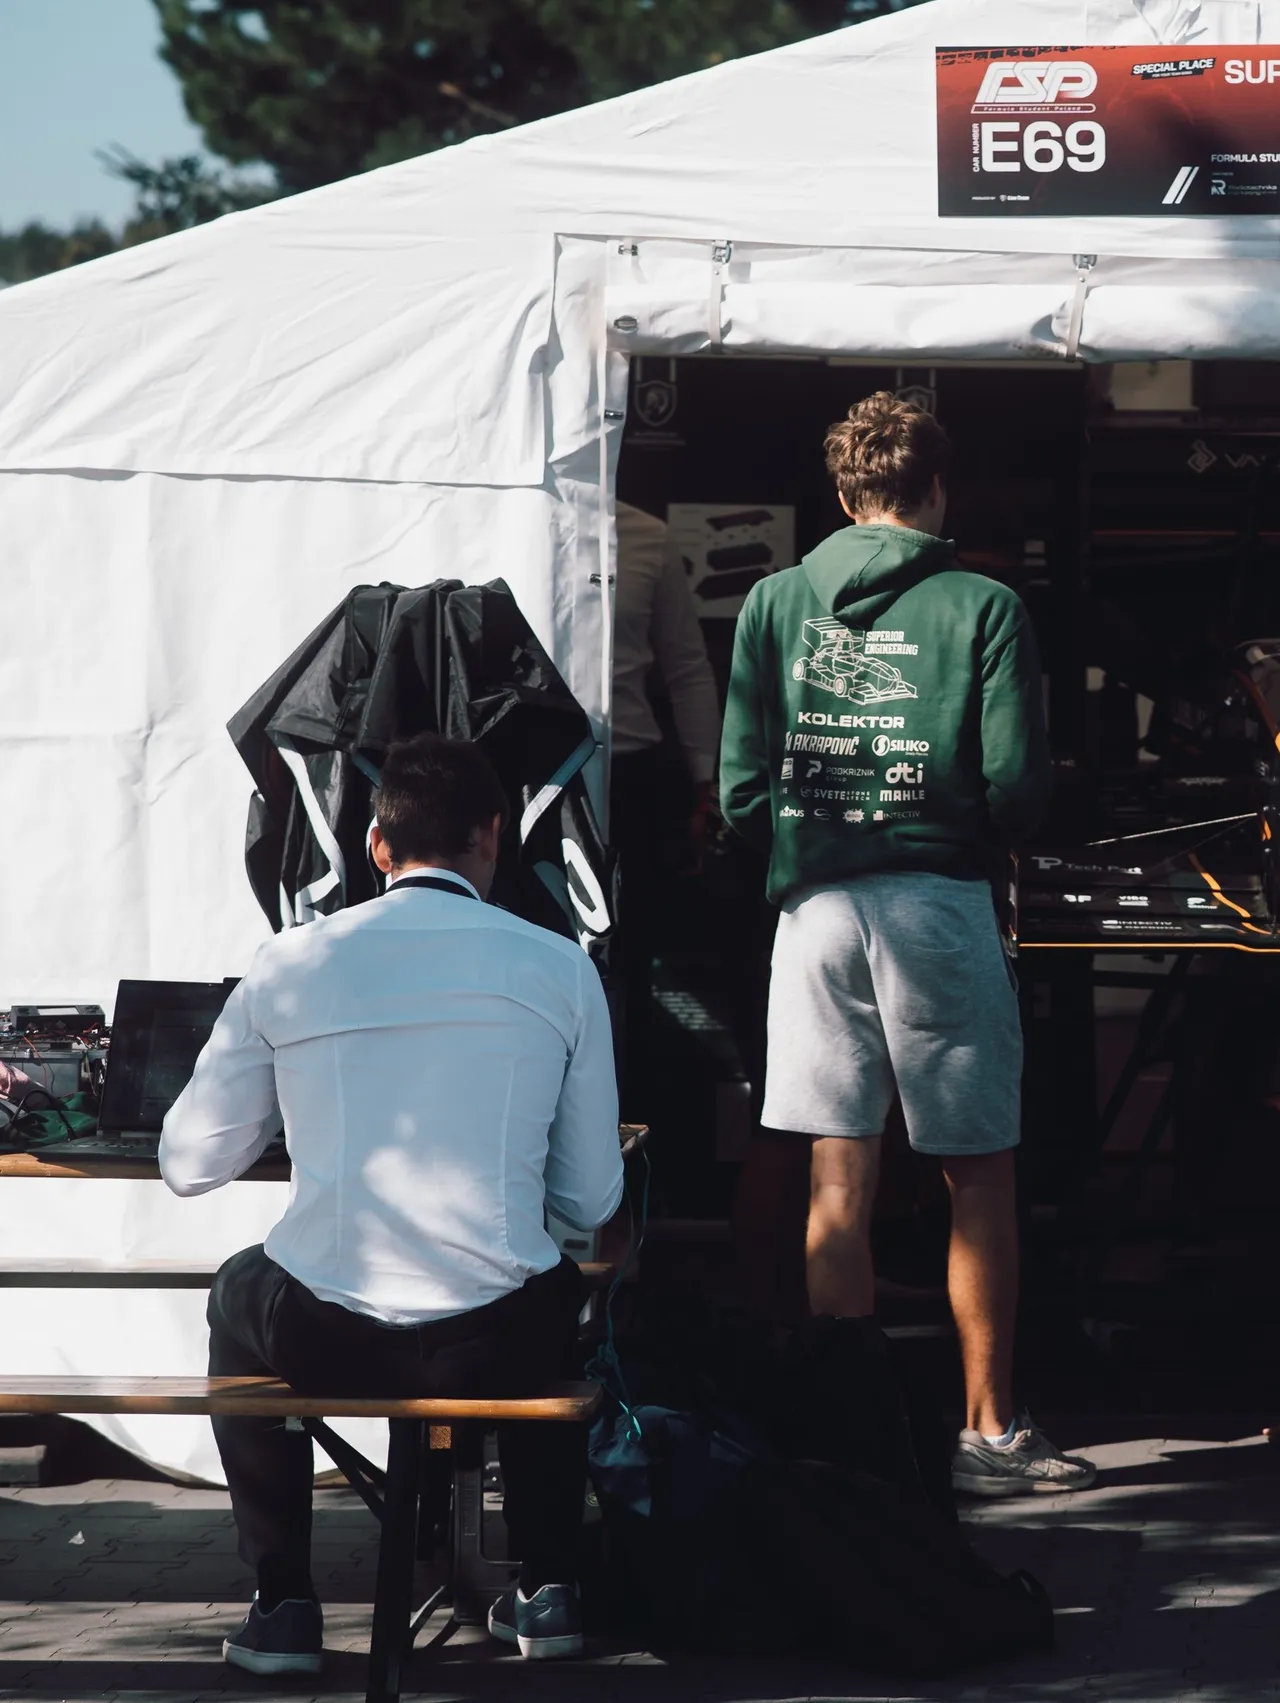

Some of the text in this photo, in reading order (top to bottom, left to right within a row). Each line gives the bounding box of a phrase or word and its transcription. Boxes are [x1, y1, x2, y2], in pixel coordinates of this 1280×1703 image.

[1132, 62, 1178, 75] SPECIAL
[1179, 58, 1214, 71] PLACE
[972, 122, 980, 172] CAR NUMBER
[981, 120, 1106, 172] E69
[1211, 153, 1258, 163] FORMULA
[866, 630, 905, 642] SUPERIOR
[864, 643, 919, 655] ENGINEERING
[797, 711, 905, 729] KOLEKTOR
[889, 739, 930, 753] SILIKO
[885, 762, 924, 784] dti
[879, 789, 926, 802] MAHLE
